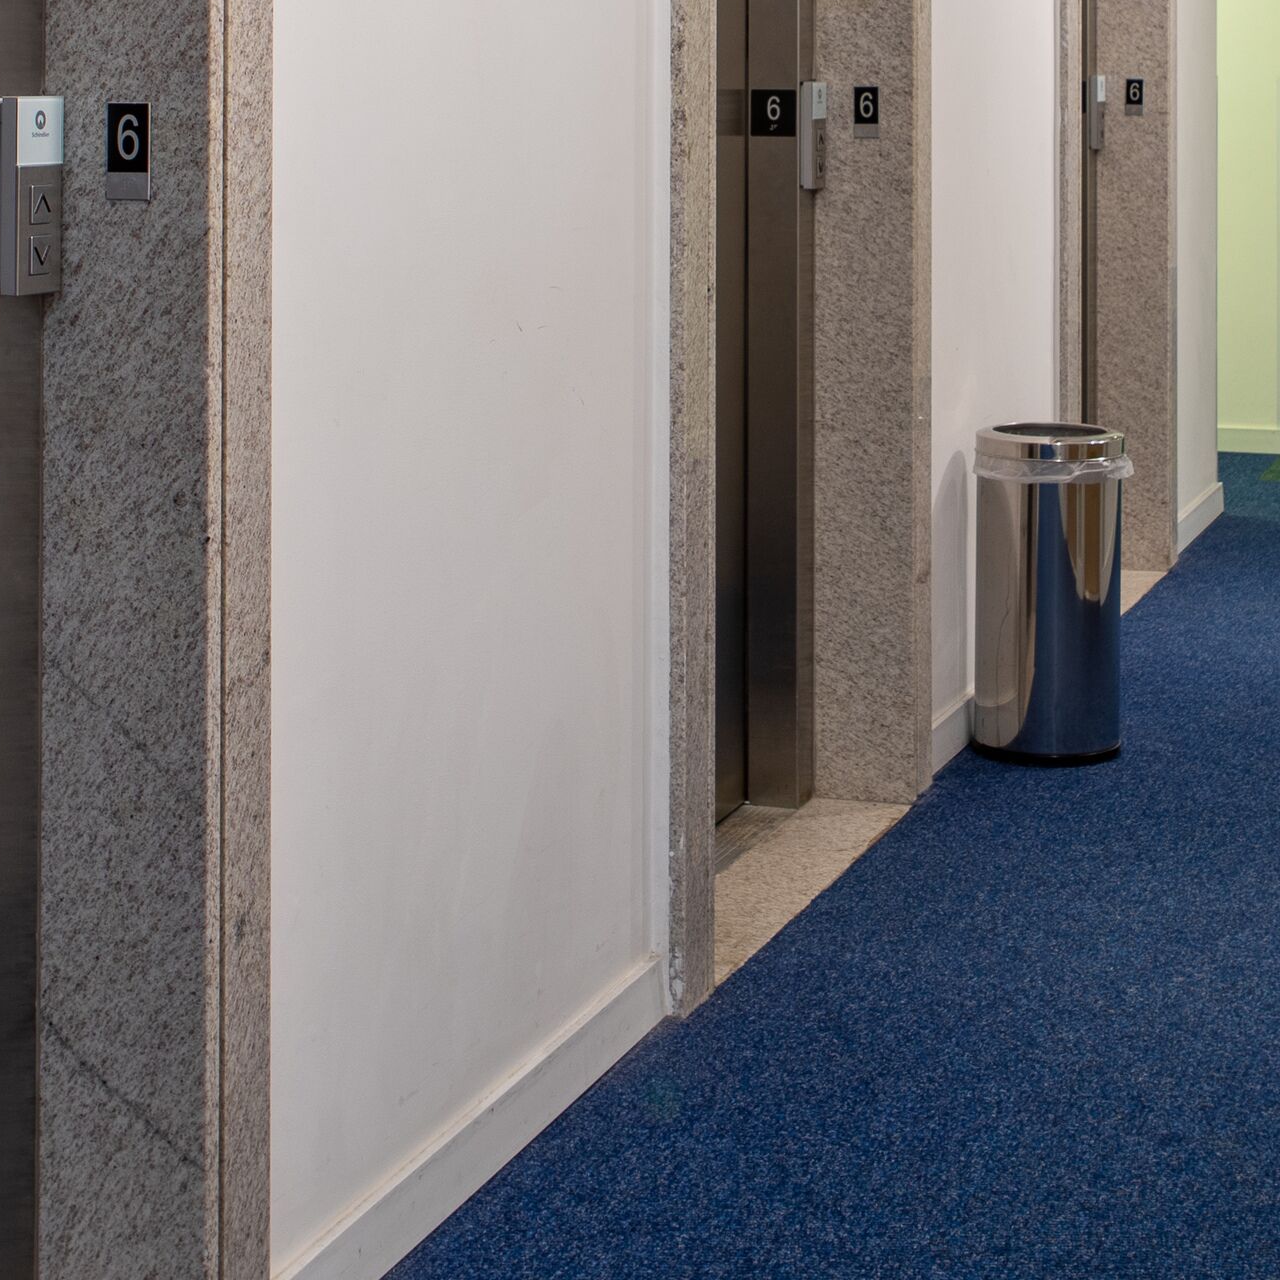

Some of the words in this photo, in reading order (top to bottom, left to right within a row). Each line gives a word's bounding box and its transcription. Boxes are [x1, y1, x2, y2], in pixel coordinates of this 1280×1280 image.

[1130, 82, 1140, 101] 6
[767, 96, 781, 120] 6
[860, 92, 874, 118] 6
[117, 113, 139, 160] 6
